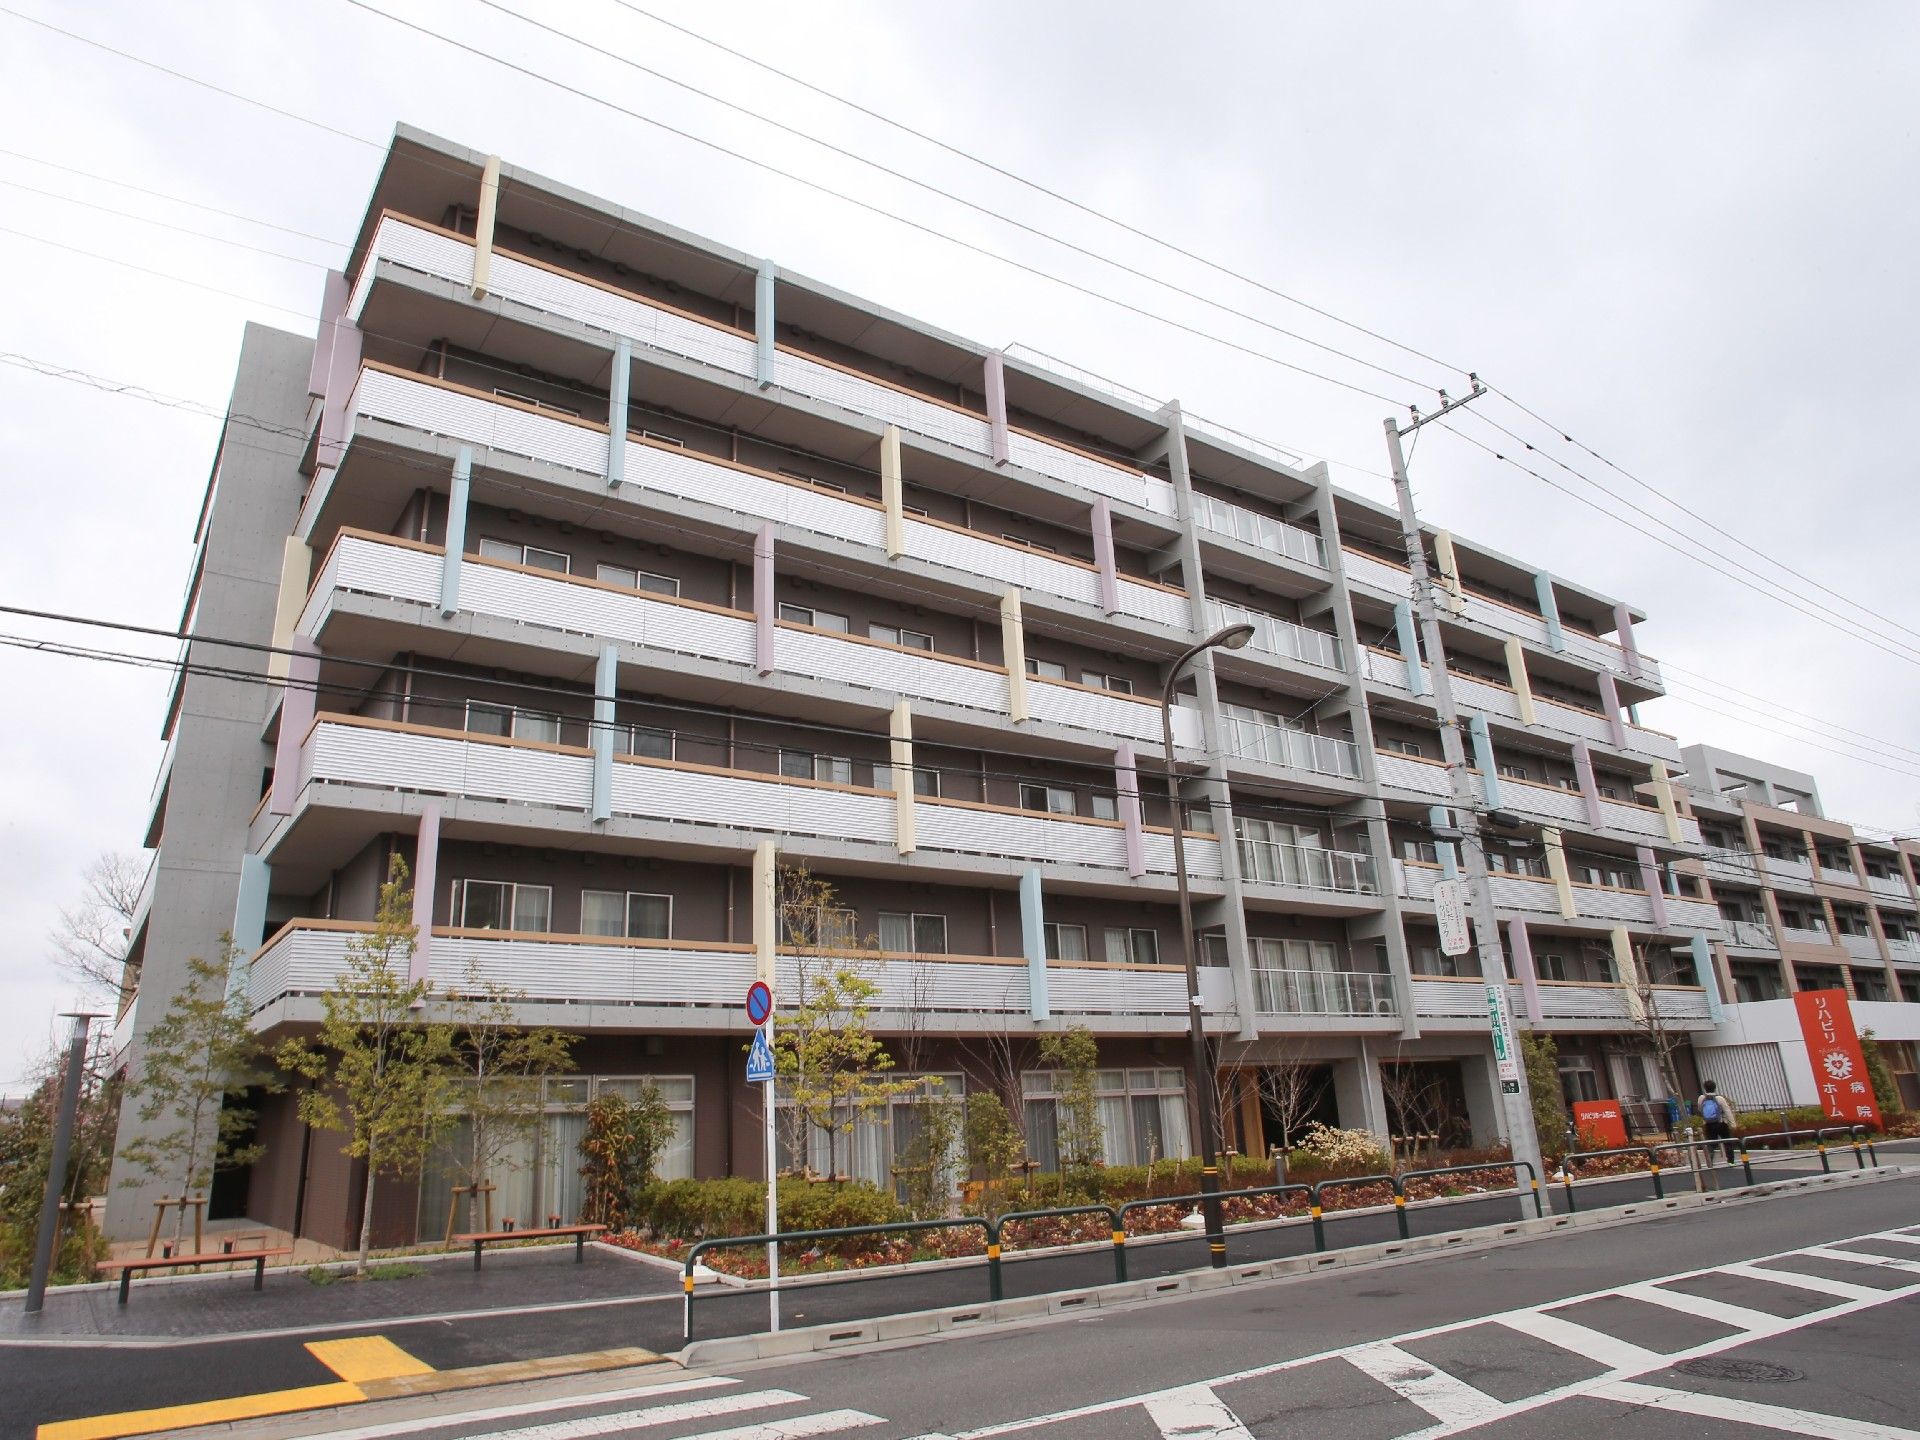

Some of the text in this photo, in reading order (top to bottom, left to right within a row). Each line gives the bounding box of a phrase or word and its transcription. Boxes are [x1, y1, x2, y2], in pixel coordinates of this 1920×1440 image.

[1815, 997, 1836, 1043] リハビリ
[1822, 1083, 1844, 1117] ホーム
[1850, 1082, 1872, 1117] 病院
